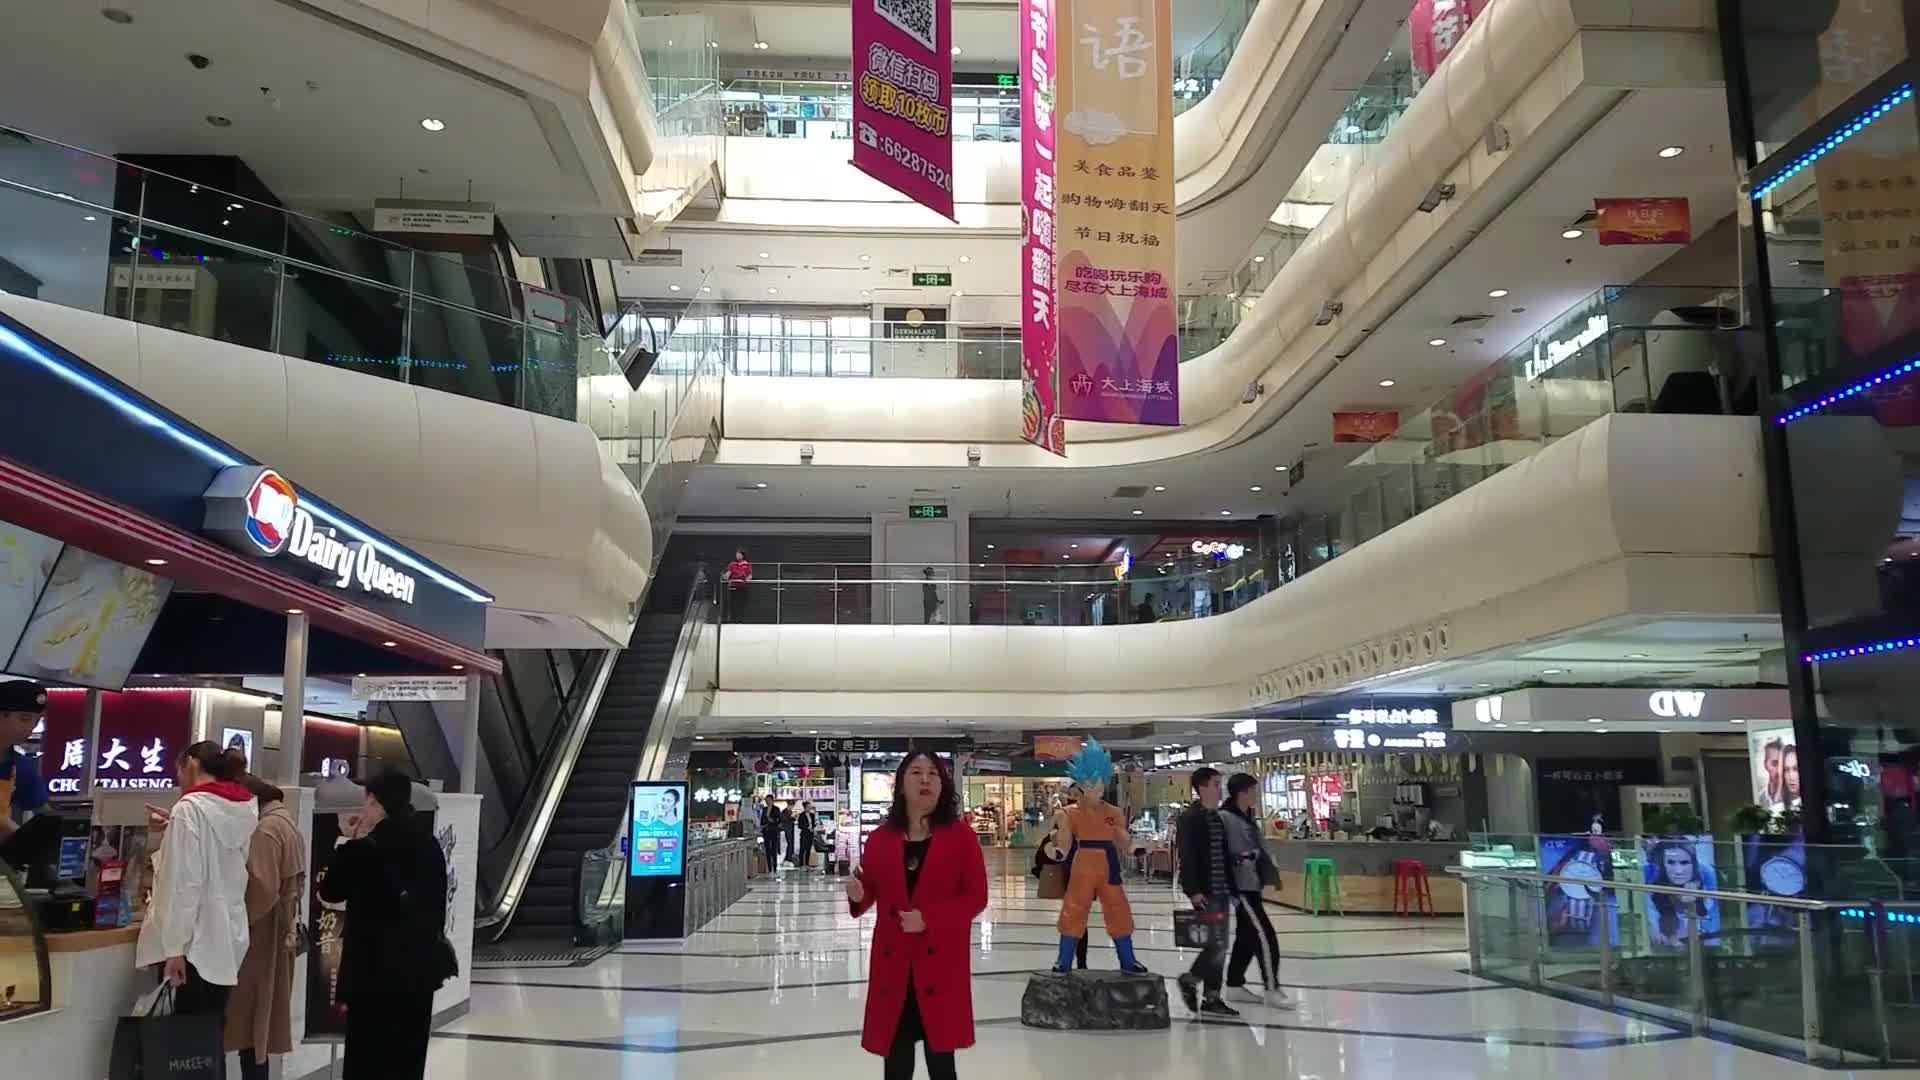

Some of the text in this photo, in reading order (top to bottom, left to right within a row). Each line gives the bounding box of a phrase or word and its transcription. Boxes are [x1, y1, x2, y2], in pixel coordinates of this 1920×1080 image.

[1079, 16, 1153, 80] 语
[868, 46, 940, 101] 微信扫码
[861, 74, 948, 134] 领取10枚币
[1072, 159, 1160, 180] 美食品鉴
[1060, 192, 1174, 215] 购物嗨翻天
[1073, 226, 1160, 247] 节日祝福
[1064, 280, 1169, 299] 尽在大上海城
[1075, 266, 1162, 285] 吃喝玩乐购
[1100, 376, 1173, 395] 大上海城
[288, 507, 416, 604] Dairy Queen
[60, 737, 166, 773] 周大生
[315, 910, 337, 953] 奶昔
